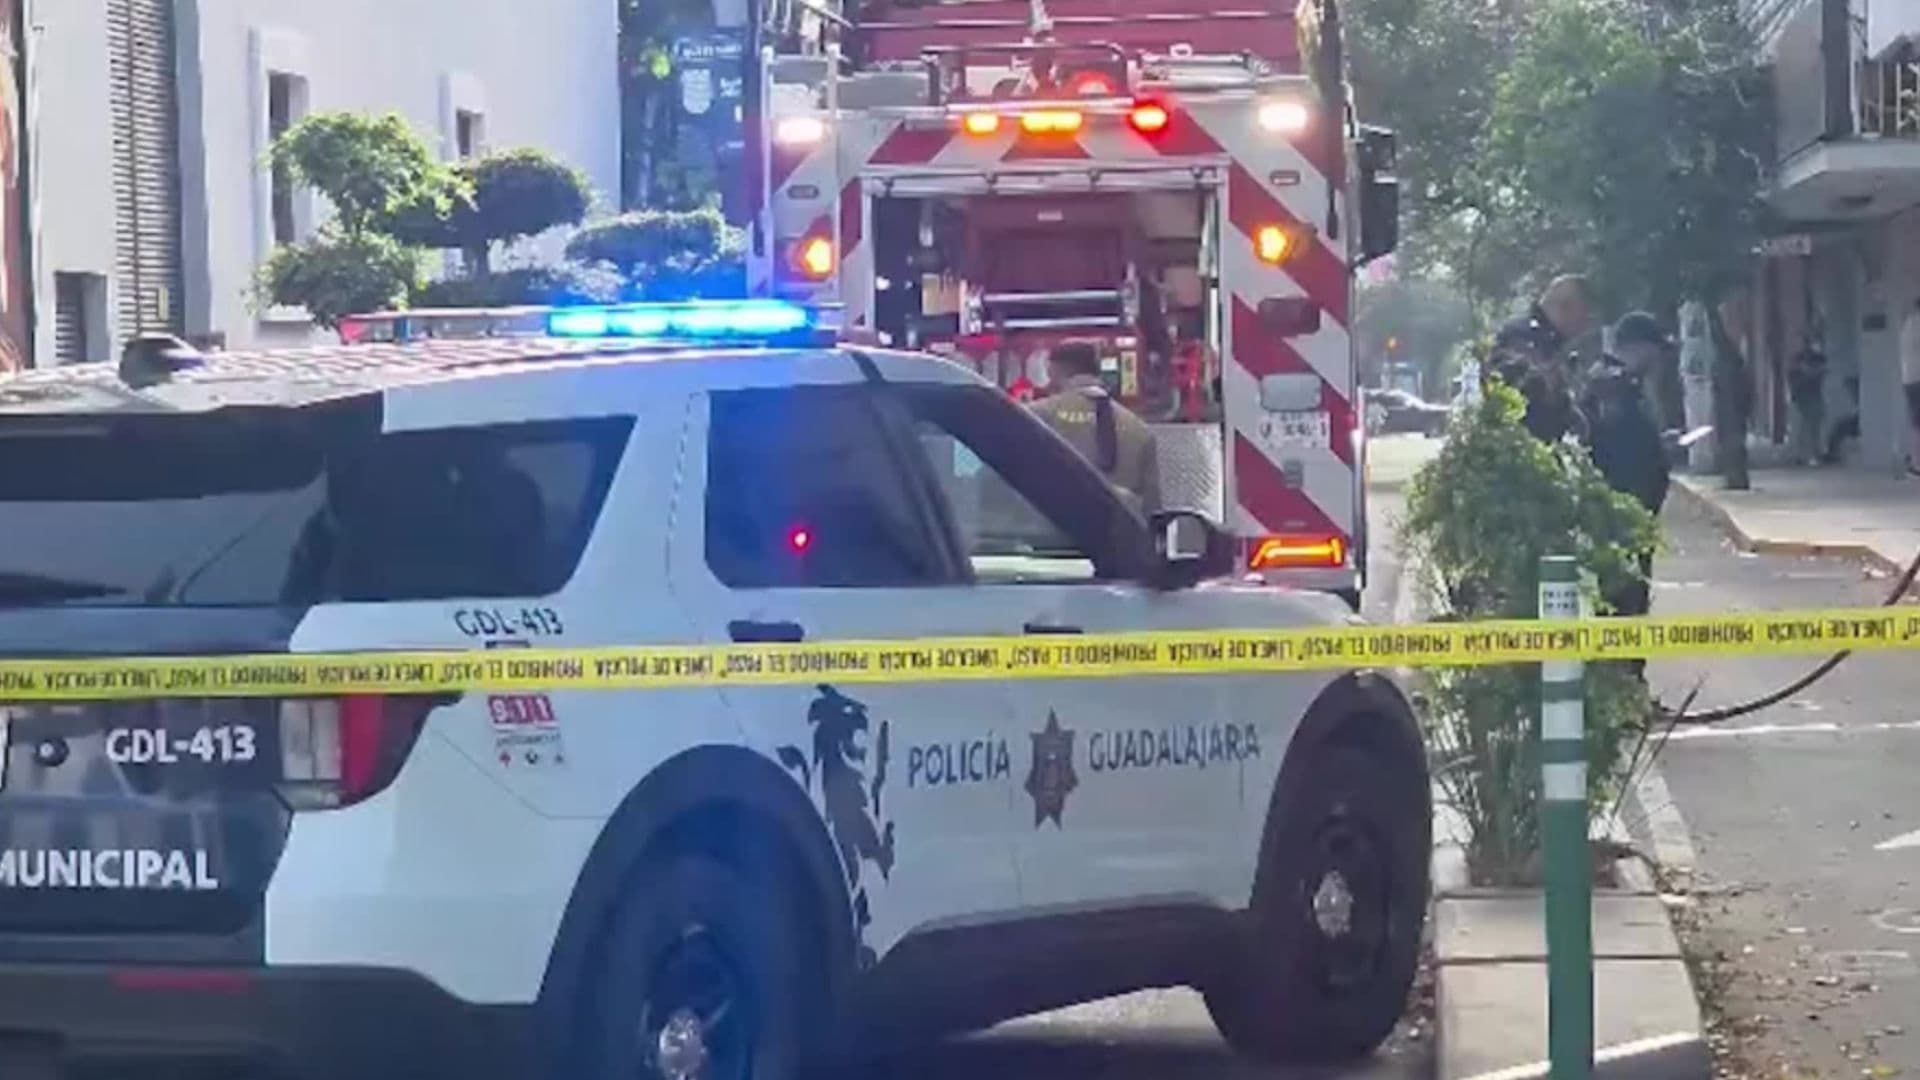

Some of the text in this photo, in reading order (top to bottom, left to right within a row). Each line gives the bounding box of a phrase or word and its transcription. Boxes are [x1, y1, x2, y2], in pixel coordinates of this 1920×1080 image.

[454, 608, 563, 636] GDL-413
[1828, 619, 1849, 637] DE
[1526, 631, 1544, 651] DE
[1647, 625, 1664, 646] EL
[1669, 623, 1753, 645] PROHIBIDO
[1056, 645, 1071, 664] EL
[1075, 643, 1157, 663] PROHIBIDO
[1228, 640, 1246, 659] DE
[1347, 637, 1364, 657] EL
[1369, 634, 1452, 656] PROHIBIDO
[653, 657, 670, 675] DE
[769, 654, 785, 673] EL
[789, 652, 868, 674] PROHIBIDO
[939, 649, 956, 667] DE
[486, 660, 503, 679] EL
[508, 659, 583, 679] PROHIBIDO
[106, 725, 257, 763] GDL-413
[908, 723, 1261, 788] POLICÍA GUADALAJARA
